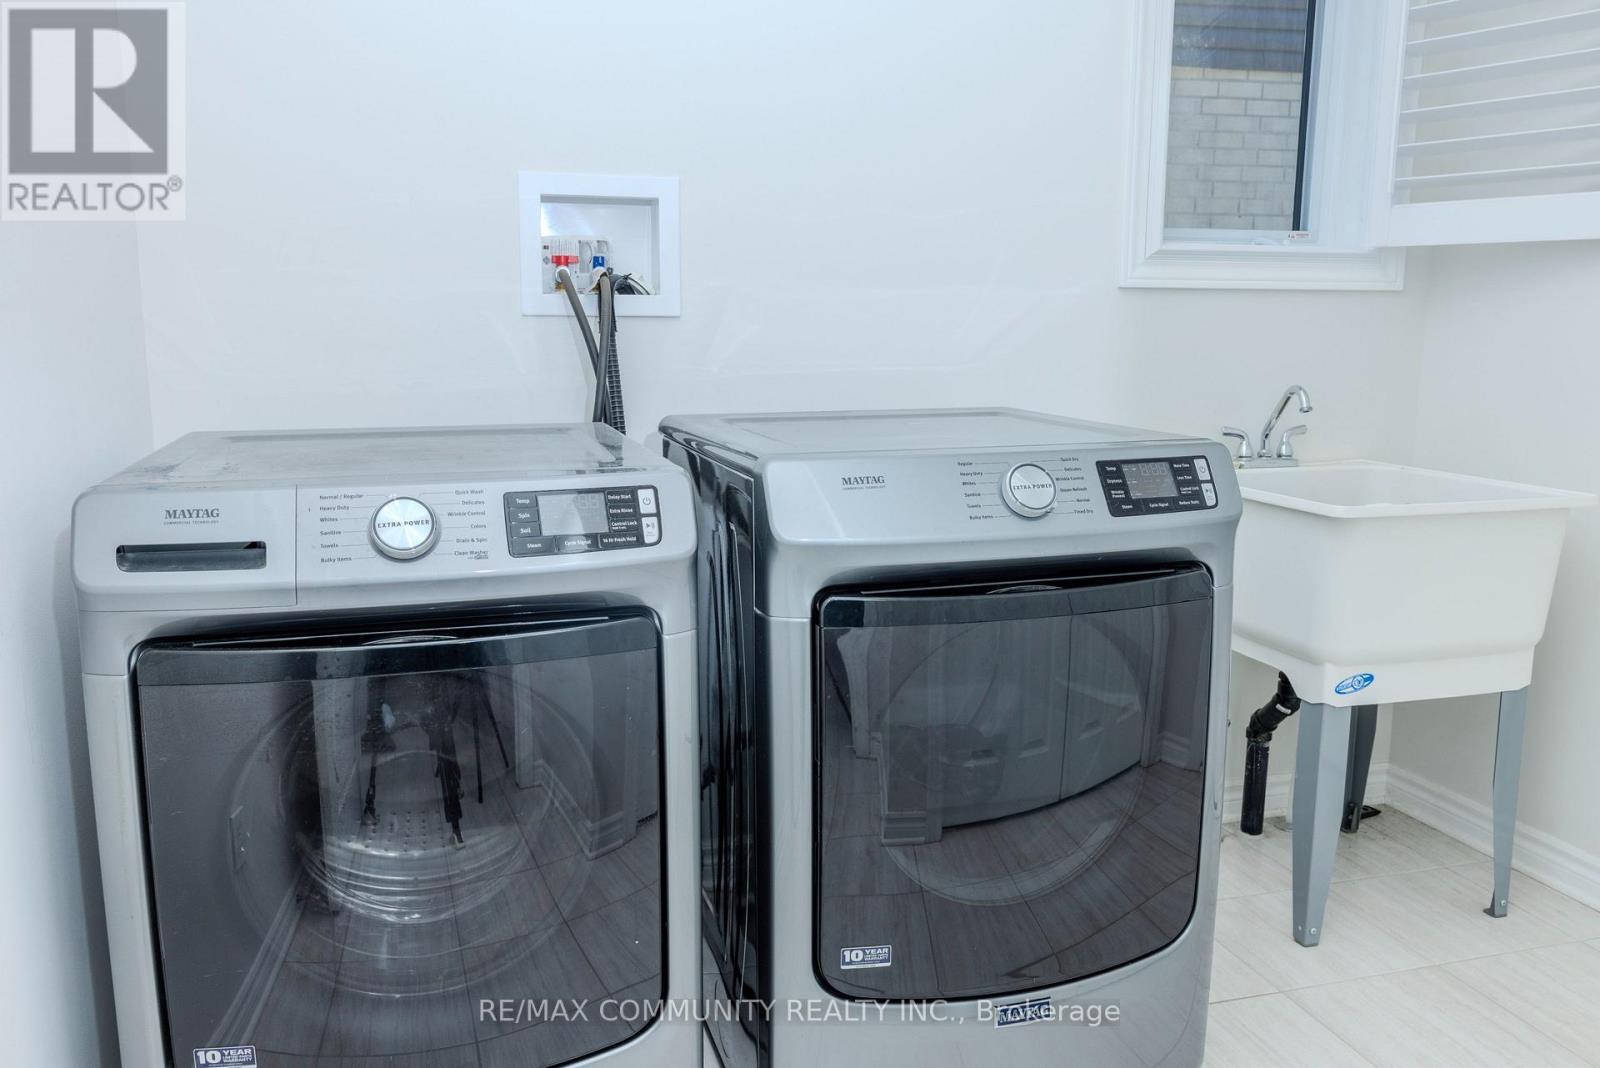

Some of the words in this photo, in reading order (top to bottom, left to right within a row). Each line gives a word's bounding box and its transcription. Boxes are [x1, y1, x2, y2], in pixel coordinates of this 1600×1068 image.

[841, 475, 885, 486] MAYTAG
[164, 508, 220, 519] MAYTAG
[843, 950, 864, 963] 10
[197, 1051, 222, 1064] 10
